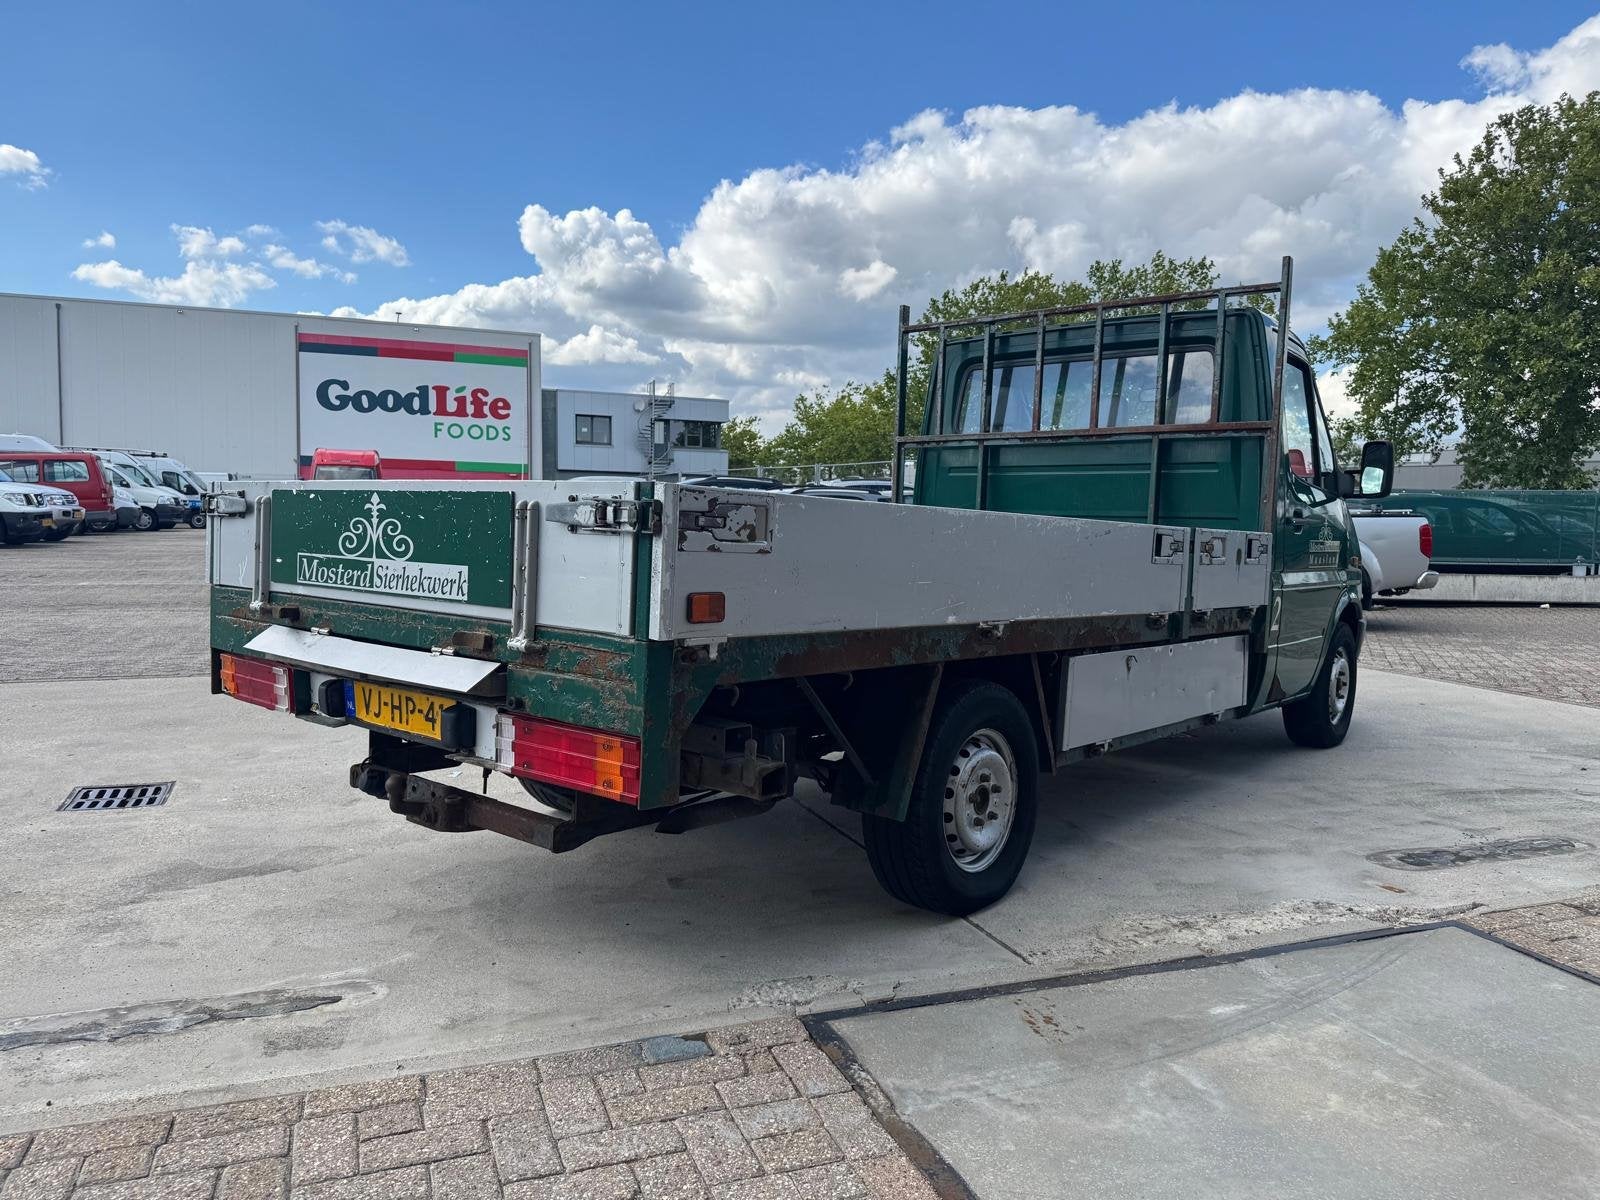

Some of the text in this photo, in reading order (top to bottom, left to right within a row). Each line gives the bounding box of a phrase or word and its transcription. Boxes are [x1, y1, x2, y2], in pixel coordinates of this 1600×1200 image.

[434, 422, 511, 442] FOODS
[299, 556, 467, 598] Mosterd Sierhekwerk
[1270, 596, 1282, 631] 2
